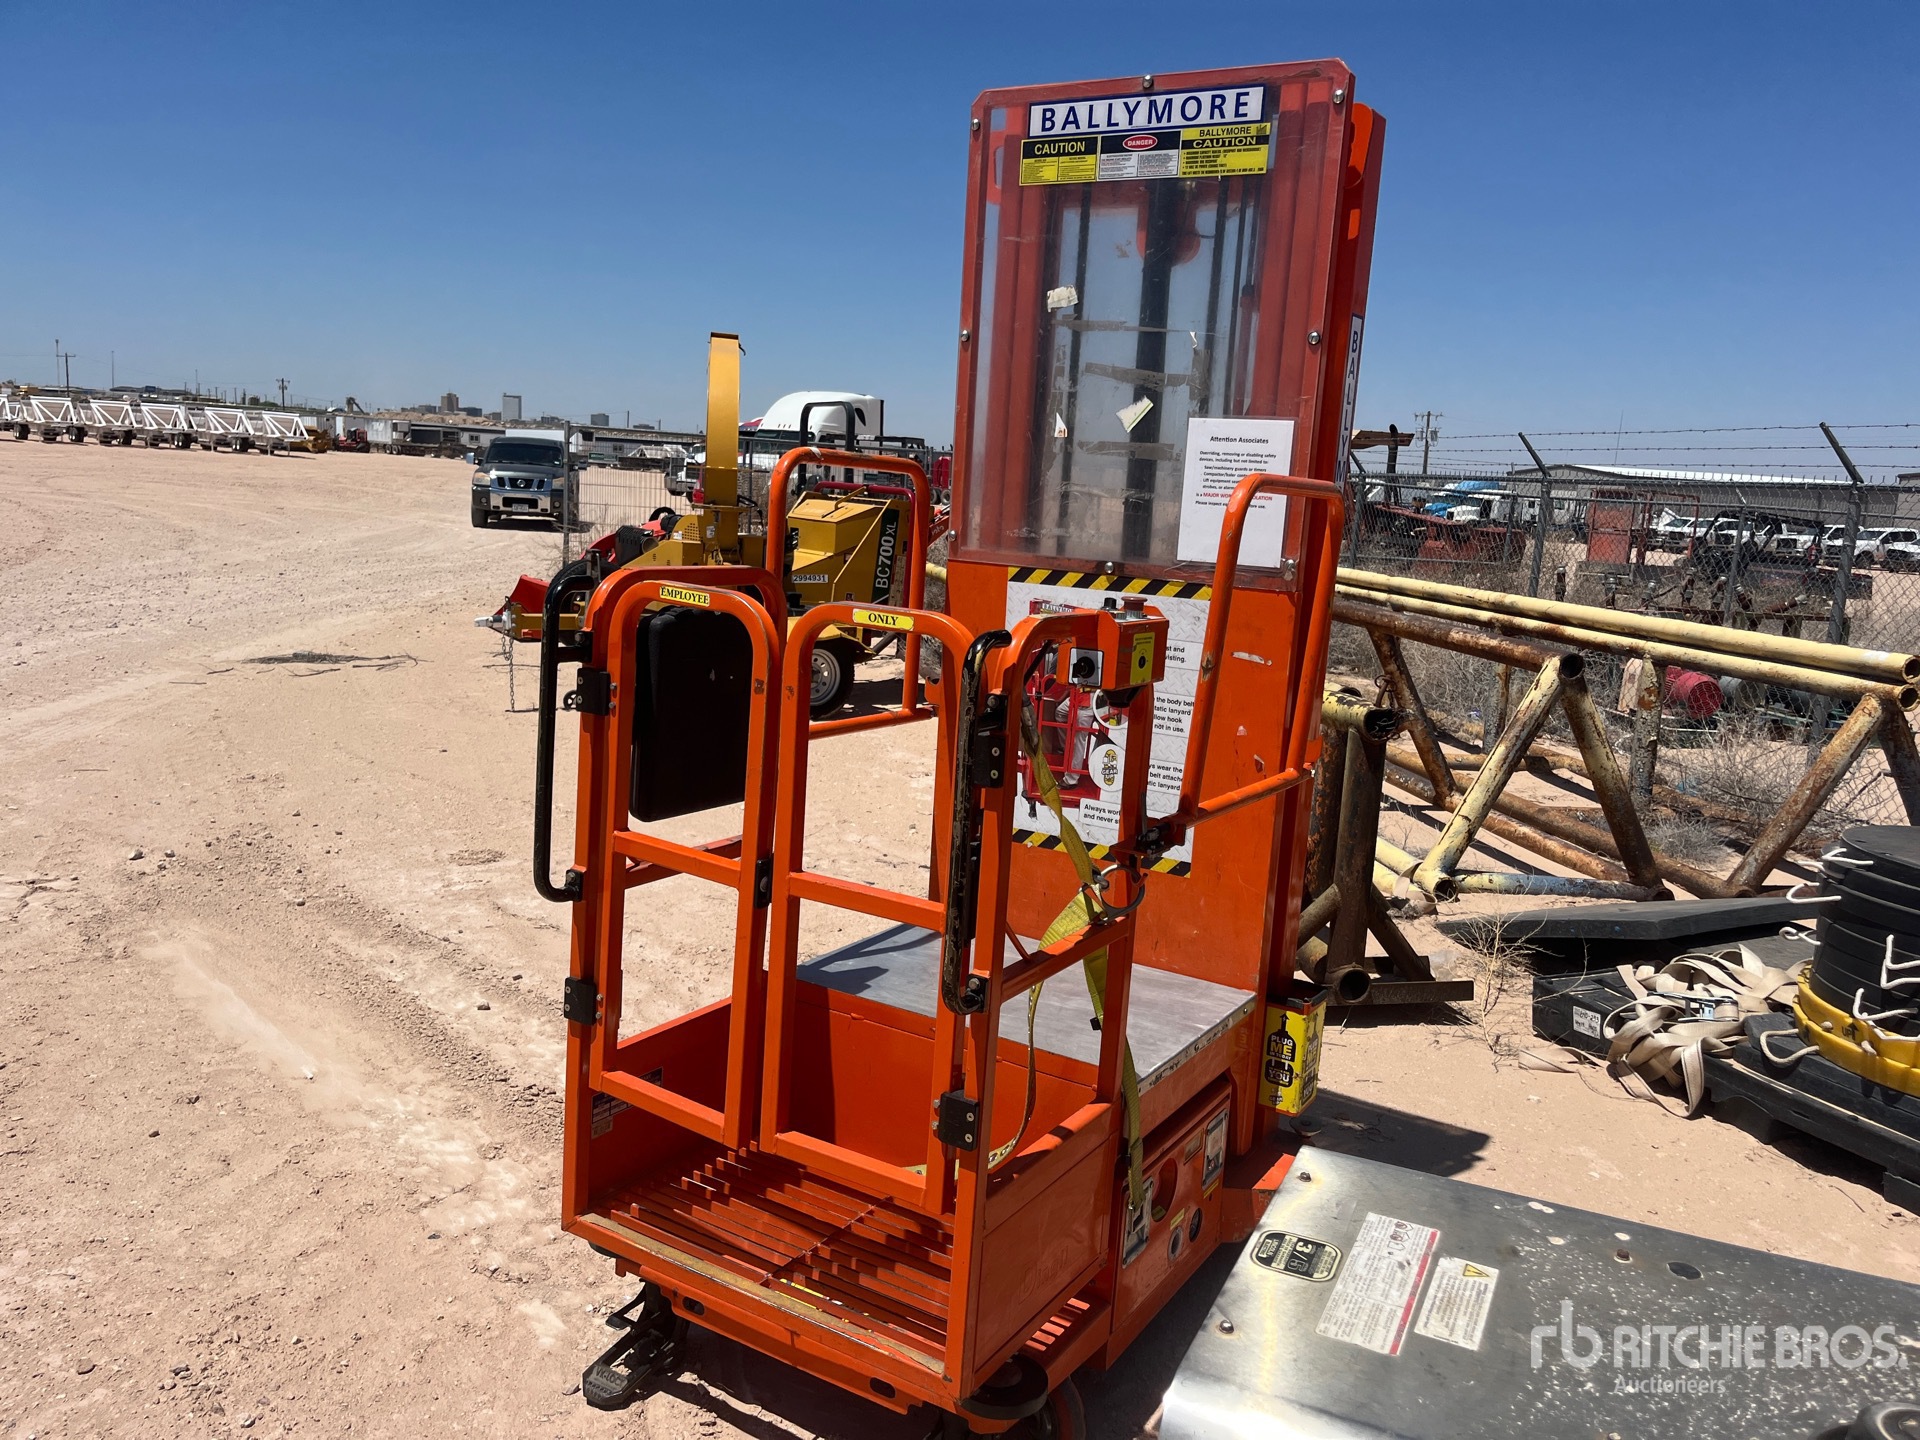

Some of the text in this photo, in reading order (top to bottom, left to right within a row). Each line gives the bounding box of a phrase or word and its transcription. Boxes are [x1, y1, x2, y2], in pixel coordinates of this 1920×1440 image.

[1041, 92, 1251, 132] BALLYMORE
[1199, 126, 1252, 137] BALLYMORE
[1034, 141, 1086, 155] CAUTION
[1127, 139, 1153, 147] DANGER
[1193, 137, 1257, 148] CAUTION
[1335, 330, 1359, 483] BALLYM
[793, 574, 826, 582] 2994931
[661, 587, 709, 605] EMPLOYEE
[868, 612, 899, 626] ONLY
[1166, 698, 1182, 706] body
[1168, 707, 1192, 716] lanyard
[1167, 715, 1182, 723] hook
[1158, 781, 1181, 790] lanyard
[1084, 804, 1106, 814] Always
[1096, 815, 1113, 823] never
[1271, 1034, 1294, 1047] PLUG
[1270, 1041, 1293, 1057] ME
[1269, 1069, 1290, 1082] YOU
